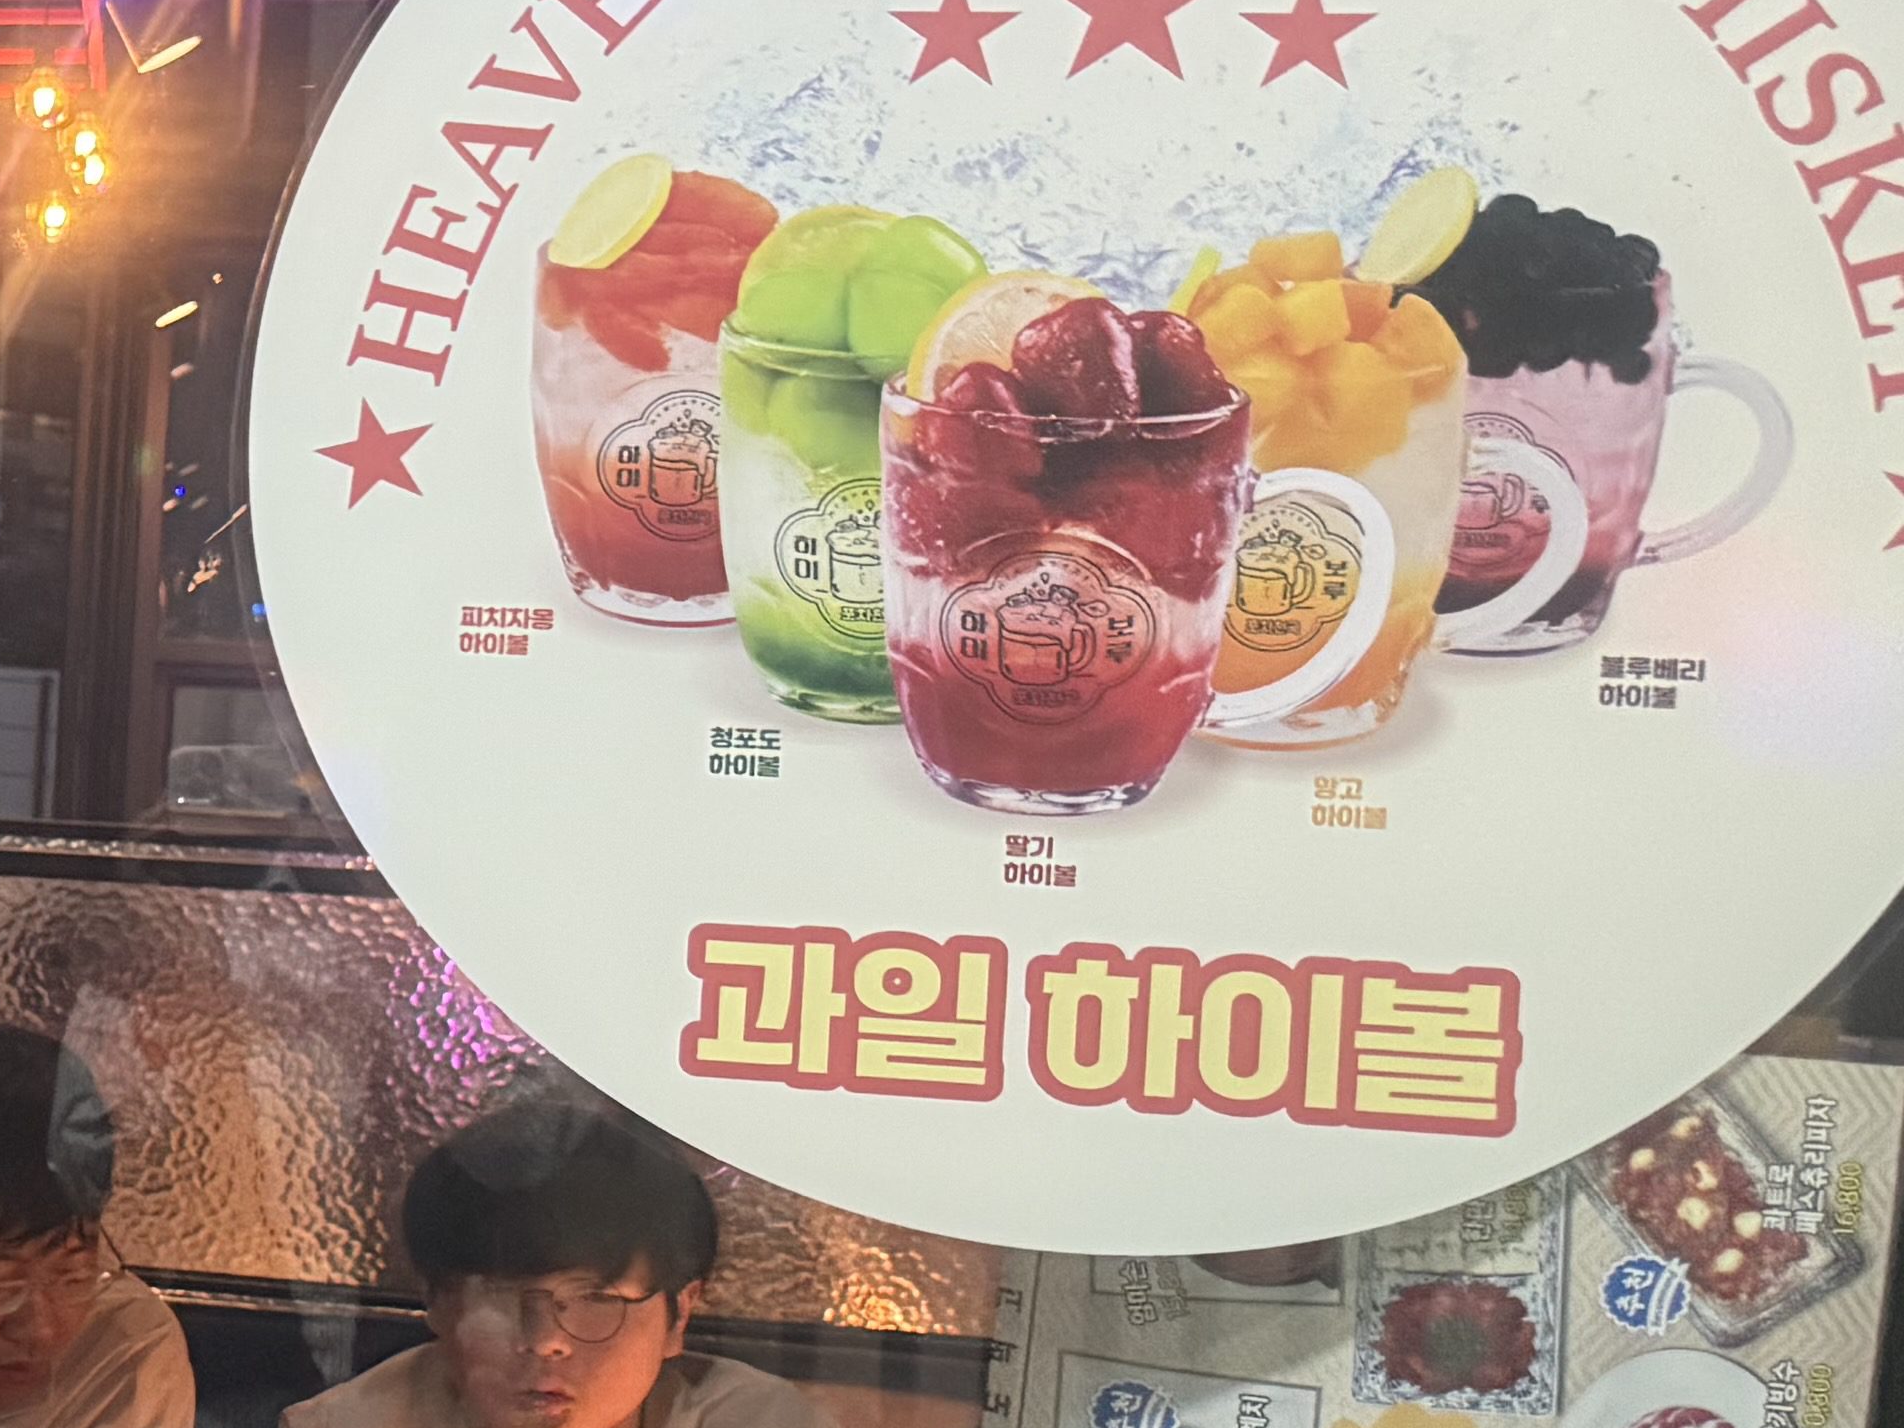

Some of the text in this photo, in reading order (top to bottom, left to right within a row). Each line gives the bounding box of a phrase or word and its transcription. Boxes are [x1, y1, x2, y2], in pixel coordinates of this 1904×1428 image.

[459, 606, 554, 631] 피치자몽
[459, 633, 529, 656] 하이볼
[1600, 655, 1707, 683] 블루베리
[1598, 685, 1678, 710] 하이볼
[709, 727, 781, 751] 청포도
[709, 754, 780, 778] 하이볼
[1310, 803, 1388, 830] 하이볼
[1005, 833, 1054, 859] 딸기
[1003, 862, 1078, 888] 하이볼
[682, 924, 1522, 1137] 과일 하이볼
[1794, 1096, 1836, 1235] 페스츄리피자
[1761, 1164, 1795, 1231] 콰트로
[1615, 1267, 1654, 1316] 추천
